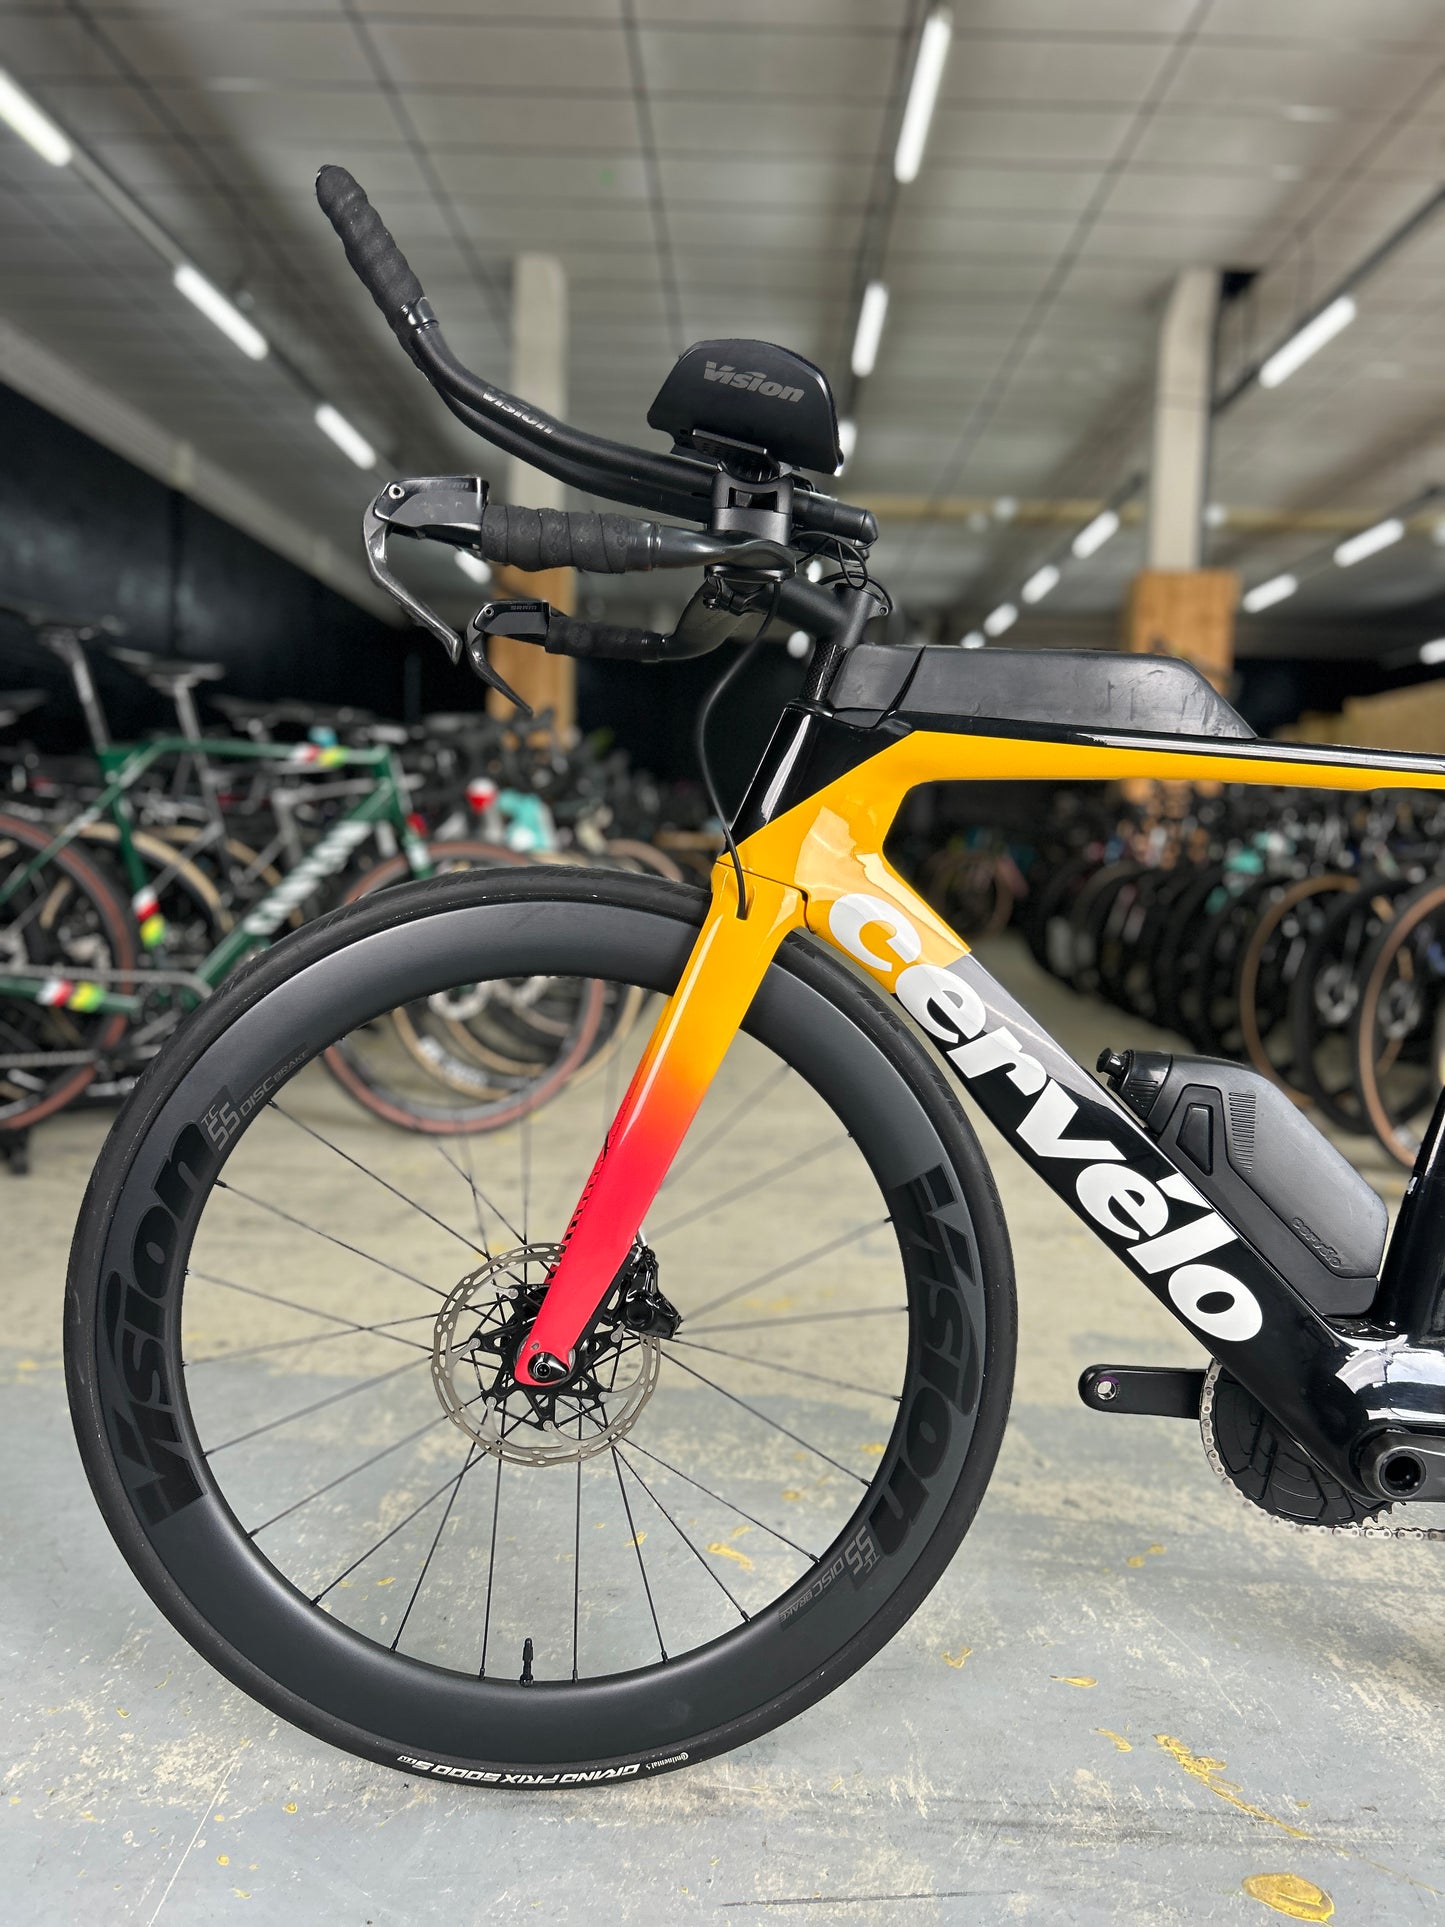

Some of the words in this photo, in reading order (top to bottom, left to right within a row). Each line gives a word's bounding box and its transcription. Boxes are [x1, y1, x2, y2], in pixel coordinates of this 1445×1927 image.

[703, 360, 805, 403] Vision
[483, 386, 555, 437] Vision
[200, 1104, 219, 1126] TC
[207, 1102, 241, 1151] 55
[240, 1076, 275, 1117] DISC
[844, 1525, 875, 1575] 55
[863, 1552, 881, 1573] TC
[812, 1557, 845, 1597] DISC
[778, 1589, 813, 1623] BRAKE
[431, 1764, 502, 1782] 5000
[500, 1773, 560, 1784] PRIX
[559, 1763, 641, 1783] GRAND
